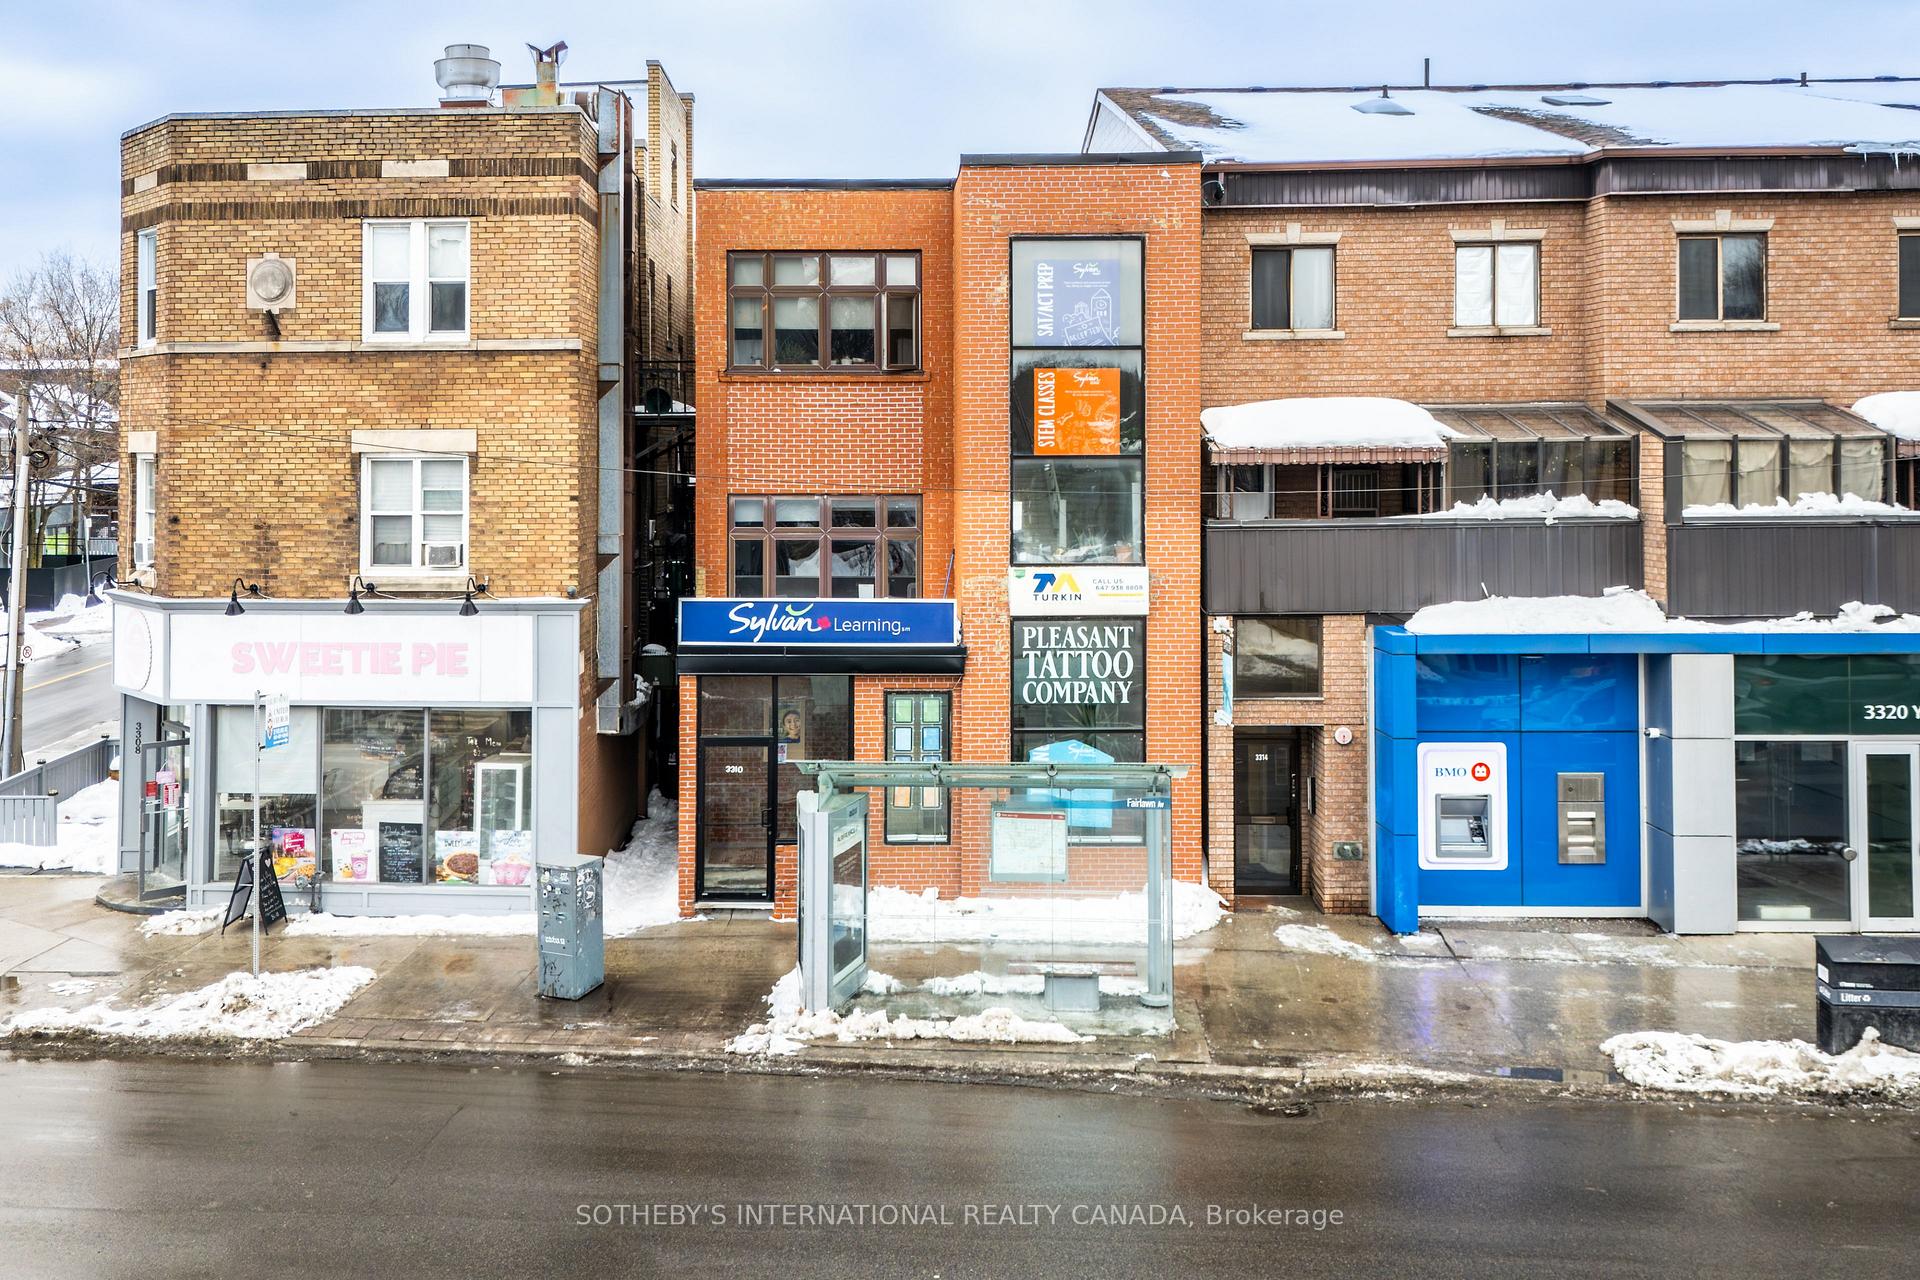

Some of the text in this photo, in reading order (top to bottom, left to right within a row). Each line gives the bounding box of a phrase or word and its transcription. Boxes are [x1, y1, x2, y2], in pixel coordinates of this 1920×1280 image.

[1073, 262, 1100, 279] Sylvan
[1037, 262, 1054, 336] SAT/ACT PREP
[1073, 372, 1100, 388] Sylvan
[1038, 372, 1055, 447] STEM CLASSES
[729, 603, 820, 642] Sylvan
[834, 618, 901, 635] Learning
[1022, 626, 1134, 649] PLEASANT
[232, 642, 469, 676] SWEETIE PIE
[1023, 650, 1134, 679] TATTOO
[1022, 681, 1133, 704] COMPANY
[1864, 704, 1909, 720] 3320
[725, 765, 743, 773] 3310
[1435, 768, 1467, 777] BMO
[1126, 797, 1156, 807] Fairlawn
[1841, 993, 1861, 1003] Litter
